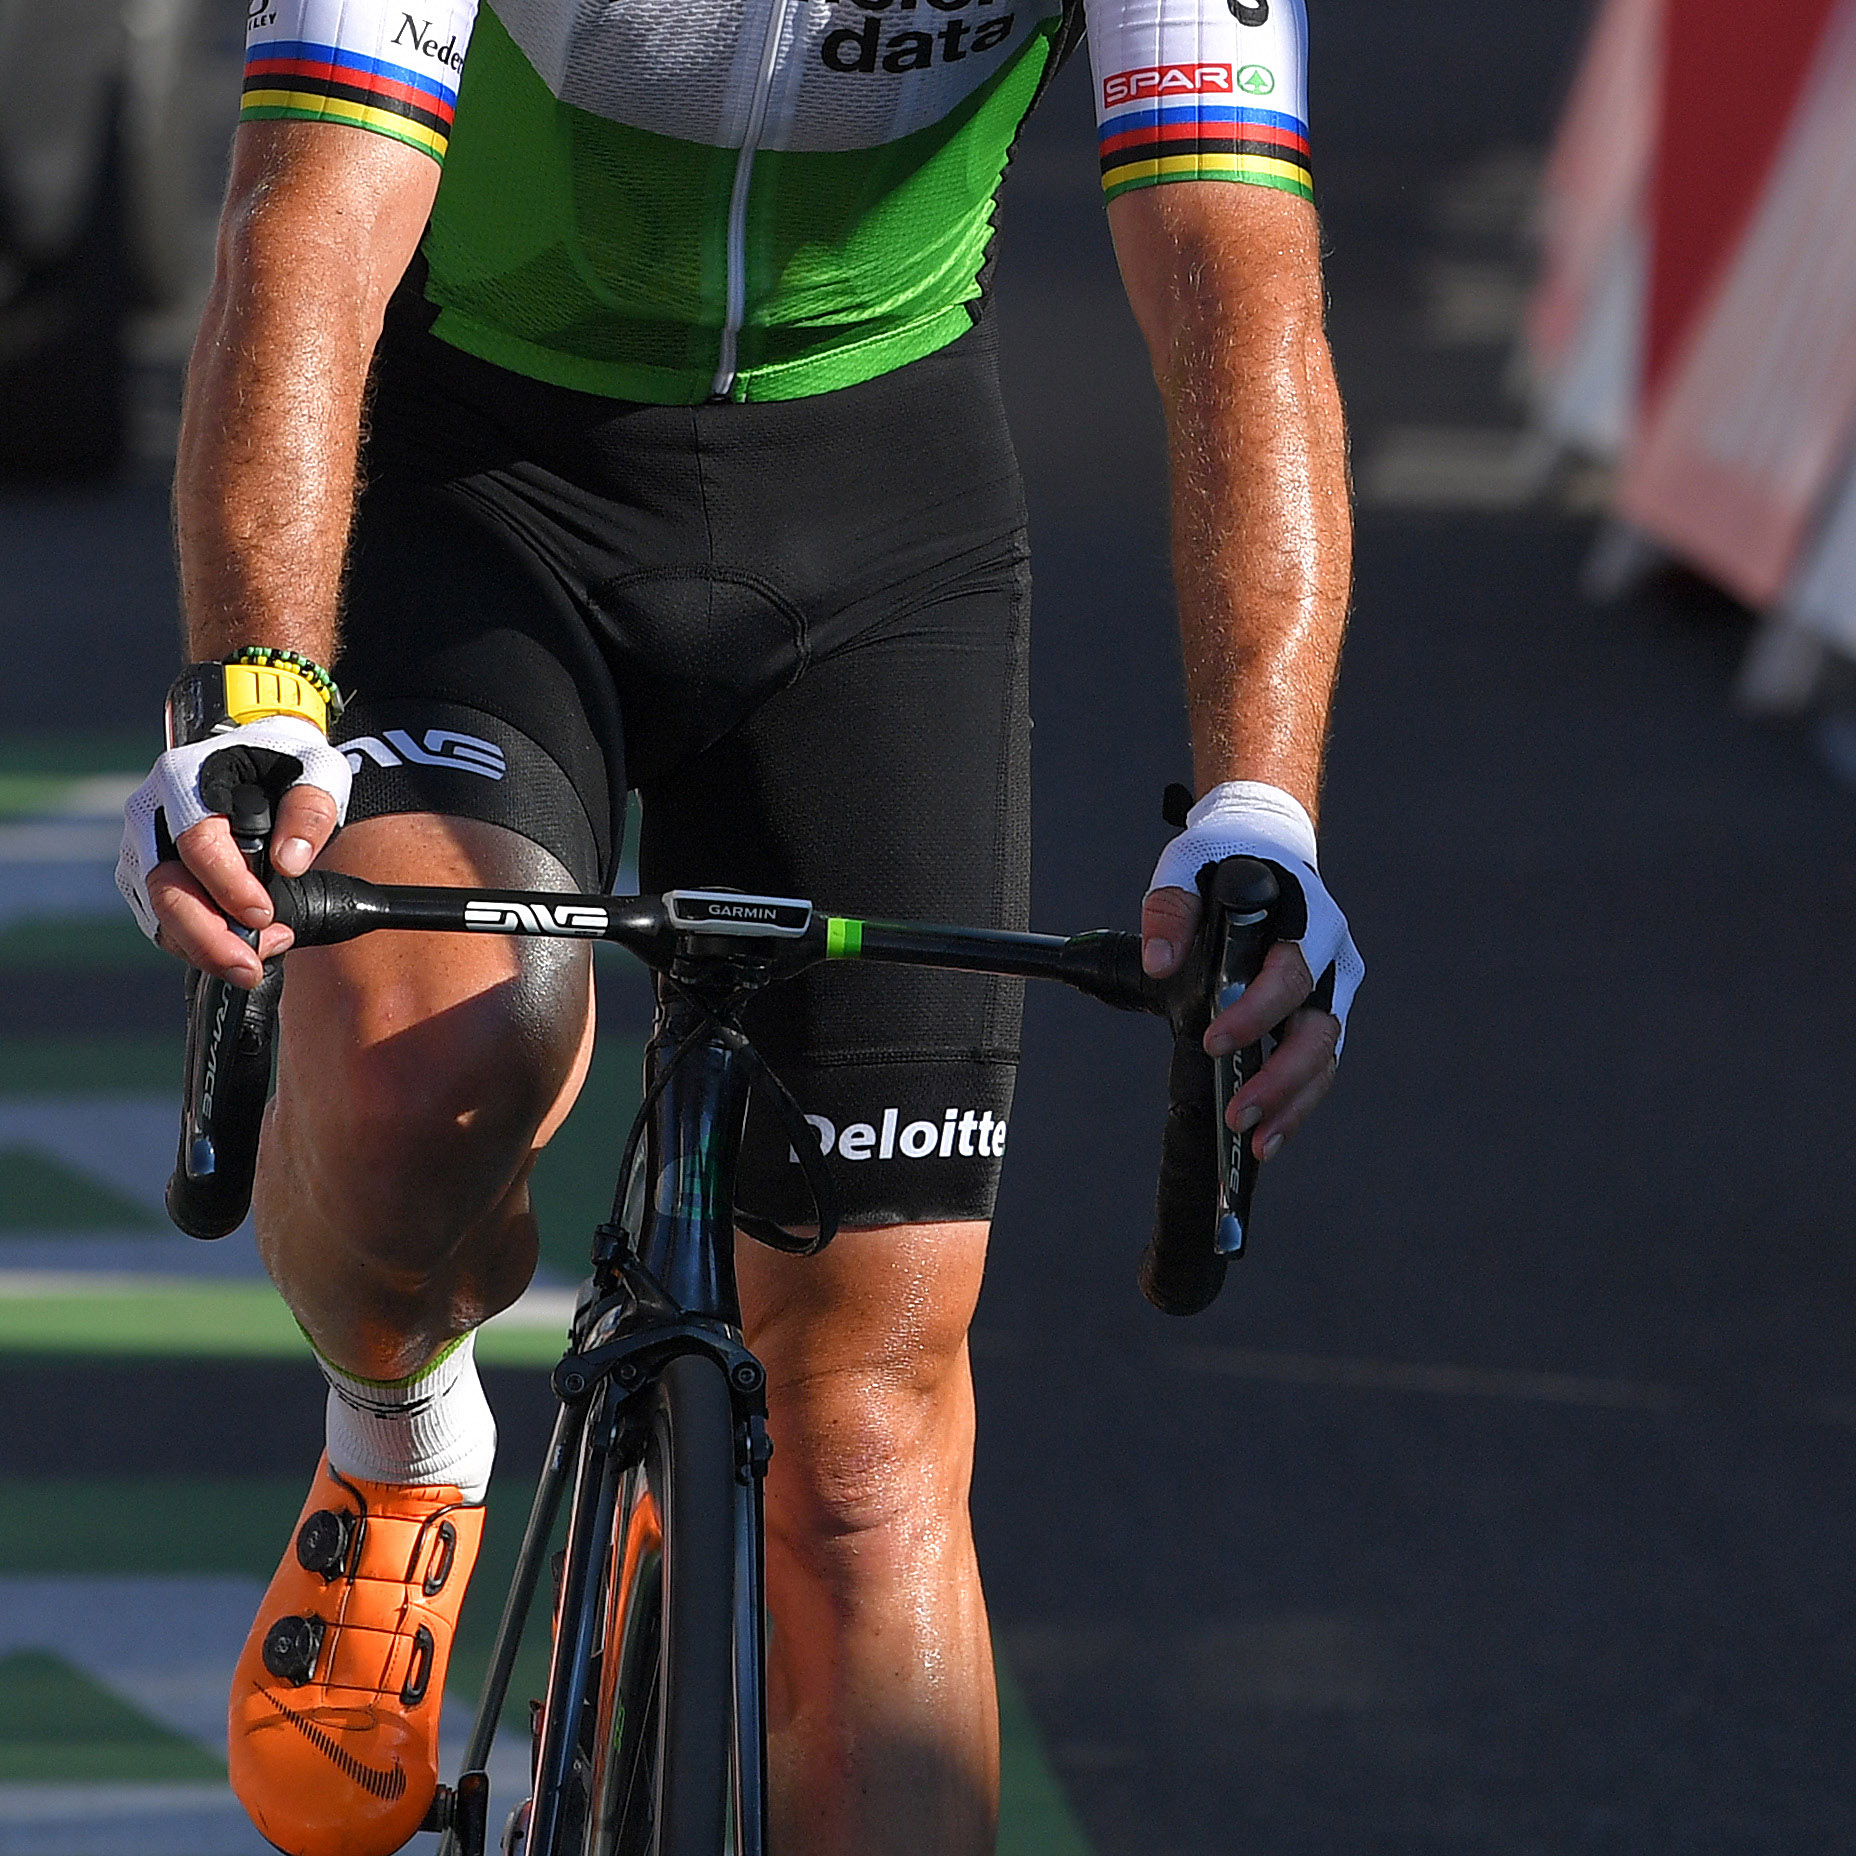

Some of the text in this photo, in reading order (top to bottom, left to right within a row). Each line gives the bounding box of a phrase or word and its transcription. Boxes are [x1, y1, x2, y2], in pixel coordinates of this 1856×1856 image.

[820, 13, 1015, 75] data
[1105, 66, 1230, 104] SPAR
[335, 728, 507, 782] NVE
[707, 903, 778, 921] GARMIN
[201, 982, 236, 1121] URA-ACE
